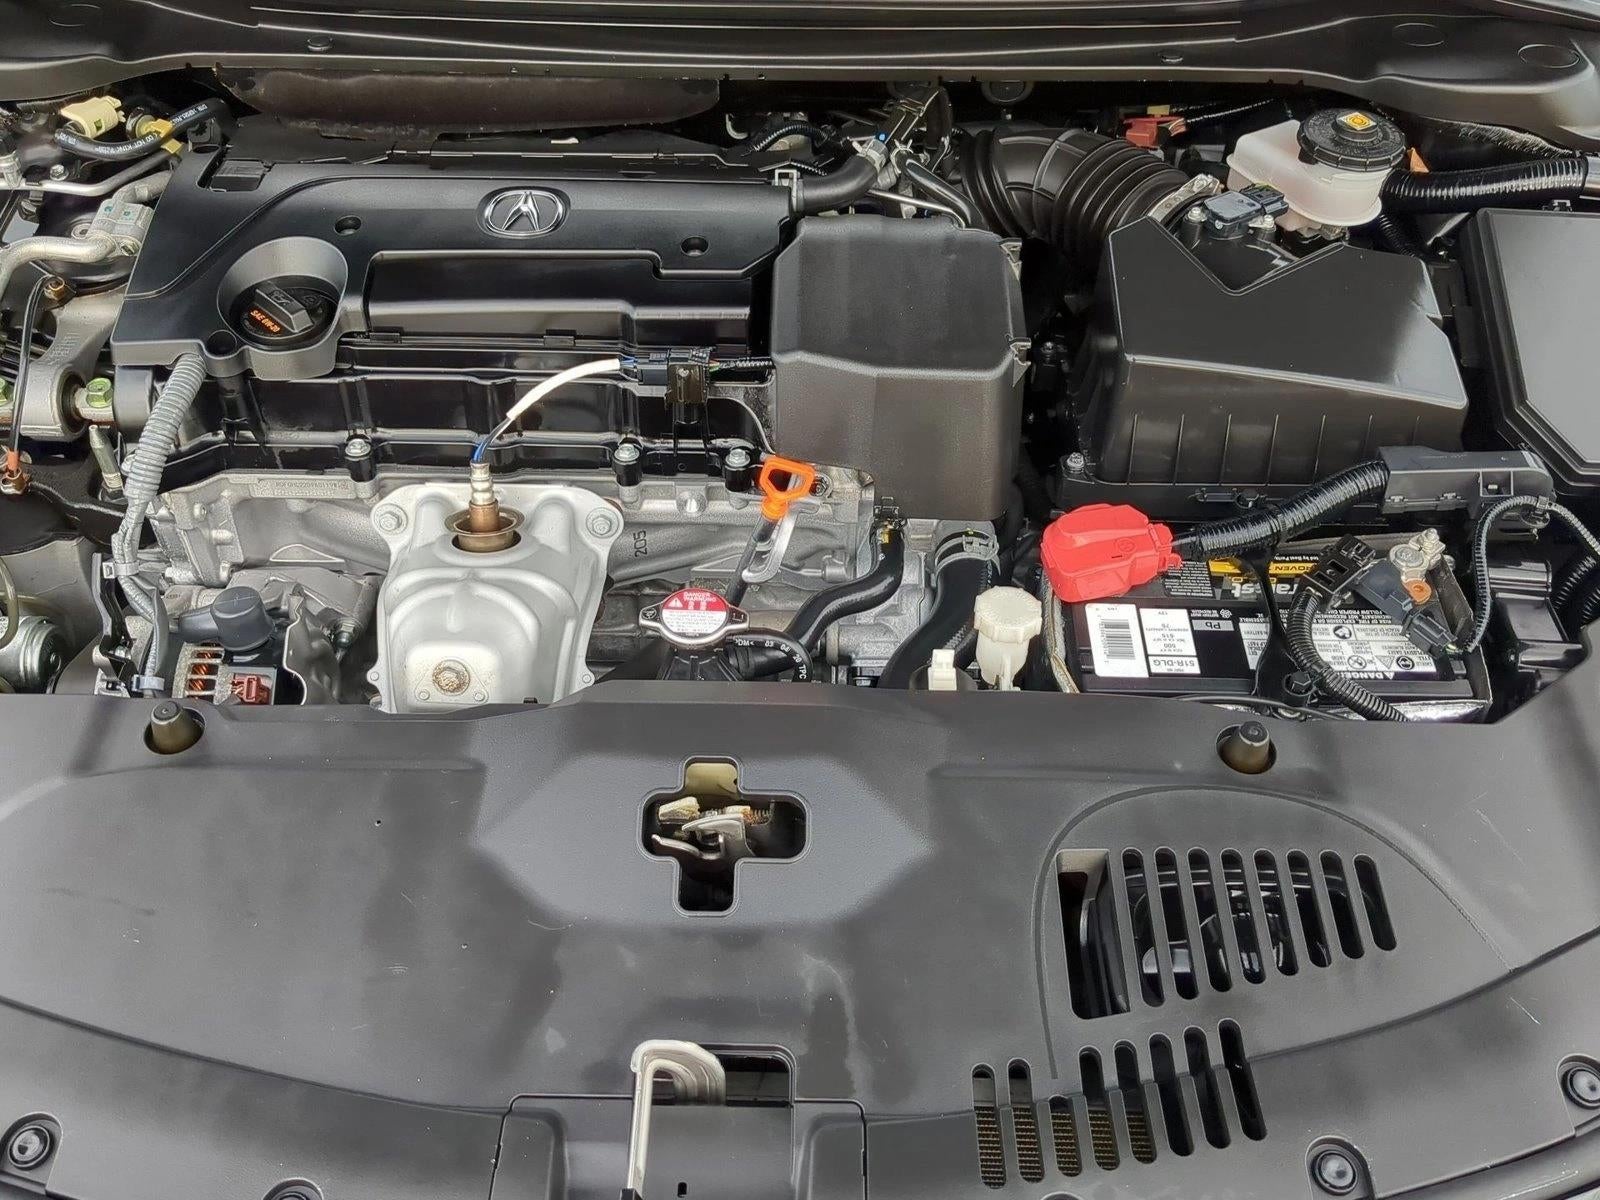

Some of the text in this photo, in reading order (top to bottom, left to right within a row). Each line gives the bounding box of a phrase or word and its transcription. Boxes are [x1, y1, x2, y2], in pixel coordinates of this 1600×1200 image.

[250, 310, 266, 321] SAE
[633, 530, 647, 557] 205
[1204, 621, 1222, 629] Pb
[1152, 659, 1195, 667] 51R-DLG
